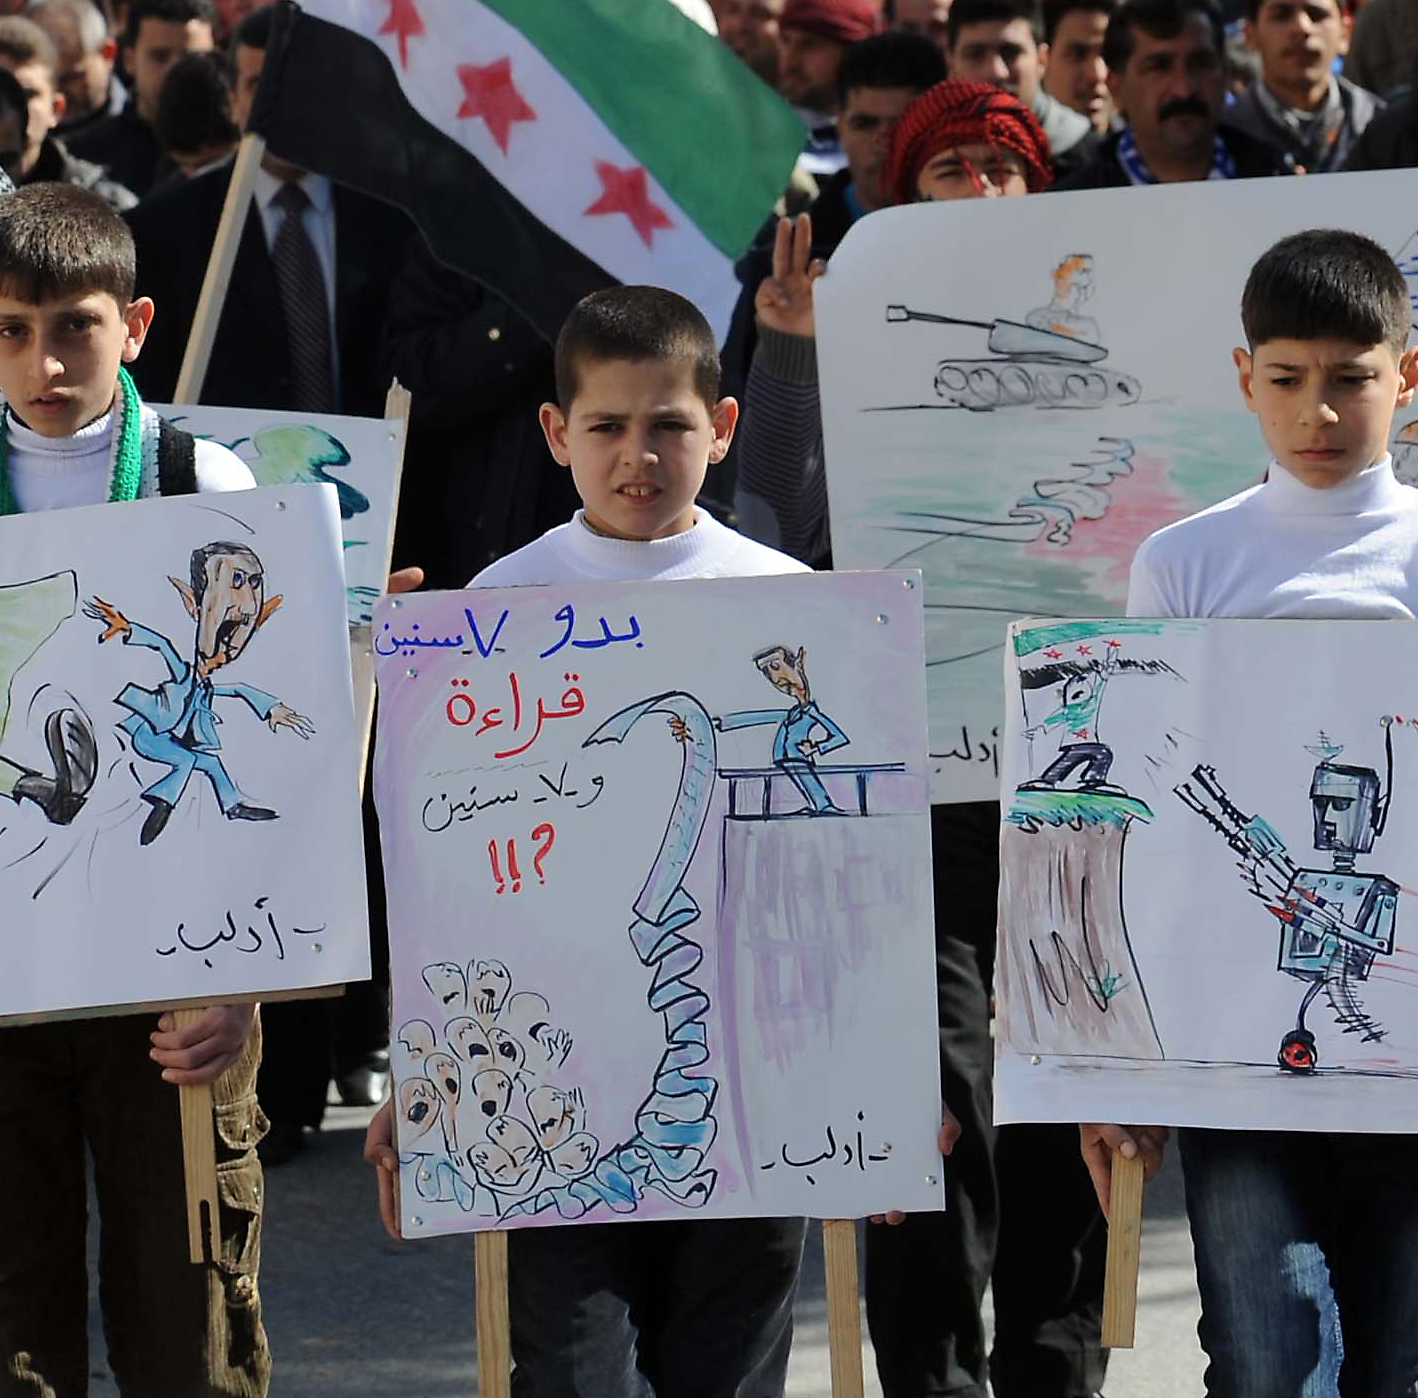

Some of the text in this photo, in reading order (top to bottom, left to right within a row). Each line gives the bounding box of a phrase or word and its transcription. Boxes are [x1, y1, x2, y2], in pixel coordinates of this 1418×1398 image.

[374, 622, 464, 657] سنين
[539, 604, 645, 659] بدو
[445, 671, 586, 760] قراءة
[422, 785, 519, 833] سنين
